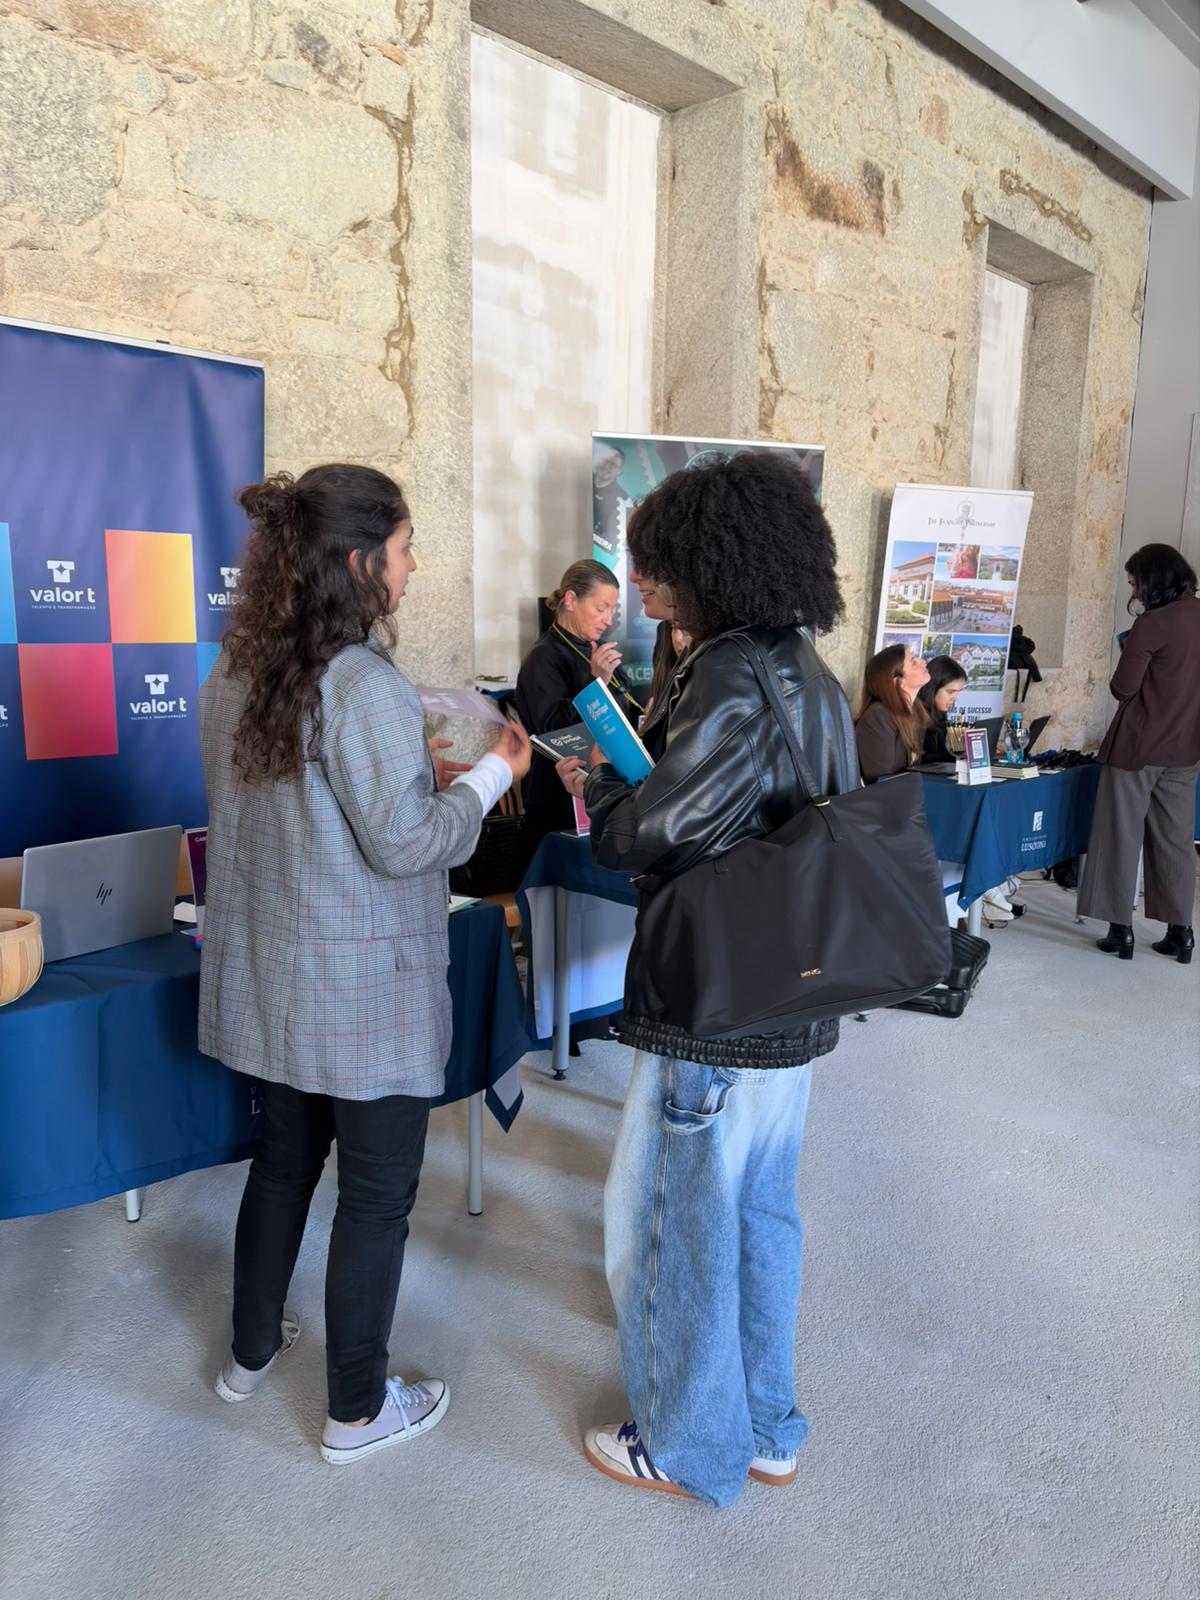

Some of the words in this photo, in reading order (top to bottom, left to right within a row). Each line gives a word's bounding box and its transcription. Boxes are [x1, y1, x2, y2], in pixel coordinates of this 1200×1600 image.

[30, 587, 84, 602] valor
[87, 587, 96, 603] t
[129, 698, 176, 714] valor
[179, 697, 187, 711] t
[967, 706, 993, 714] SUCESSO
[96, 882, 113, 905] hp
